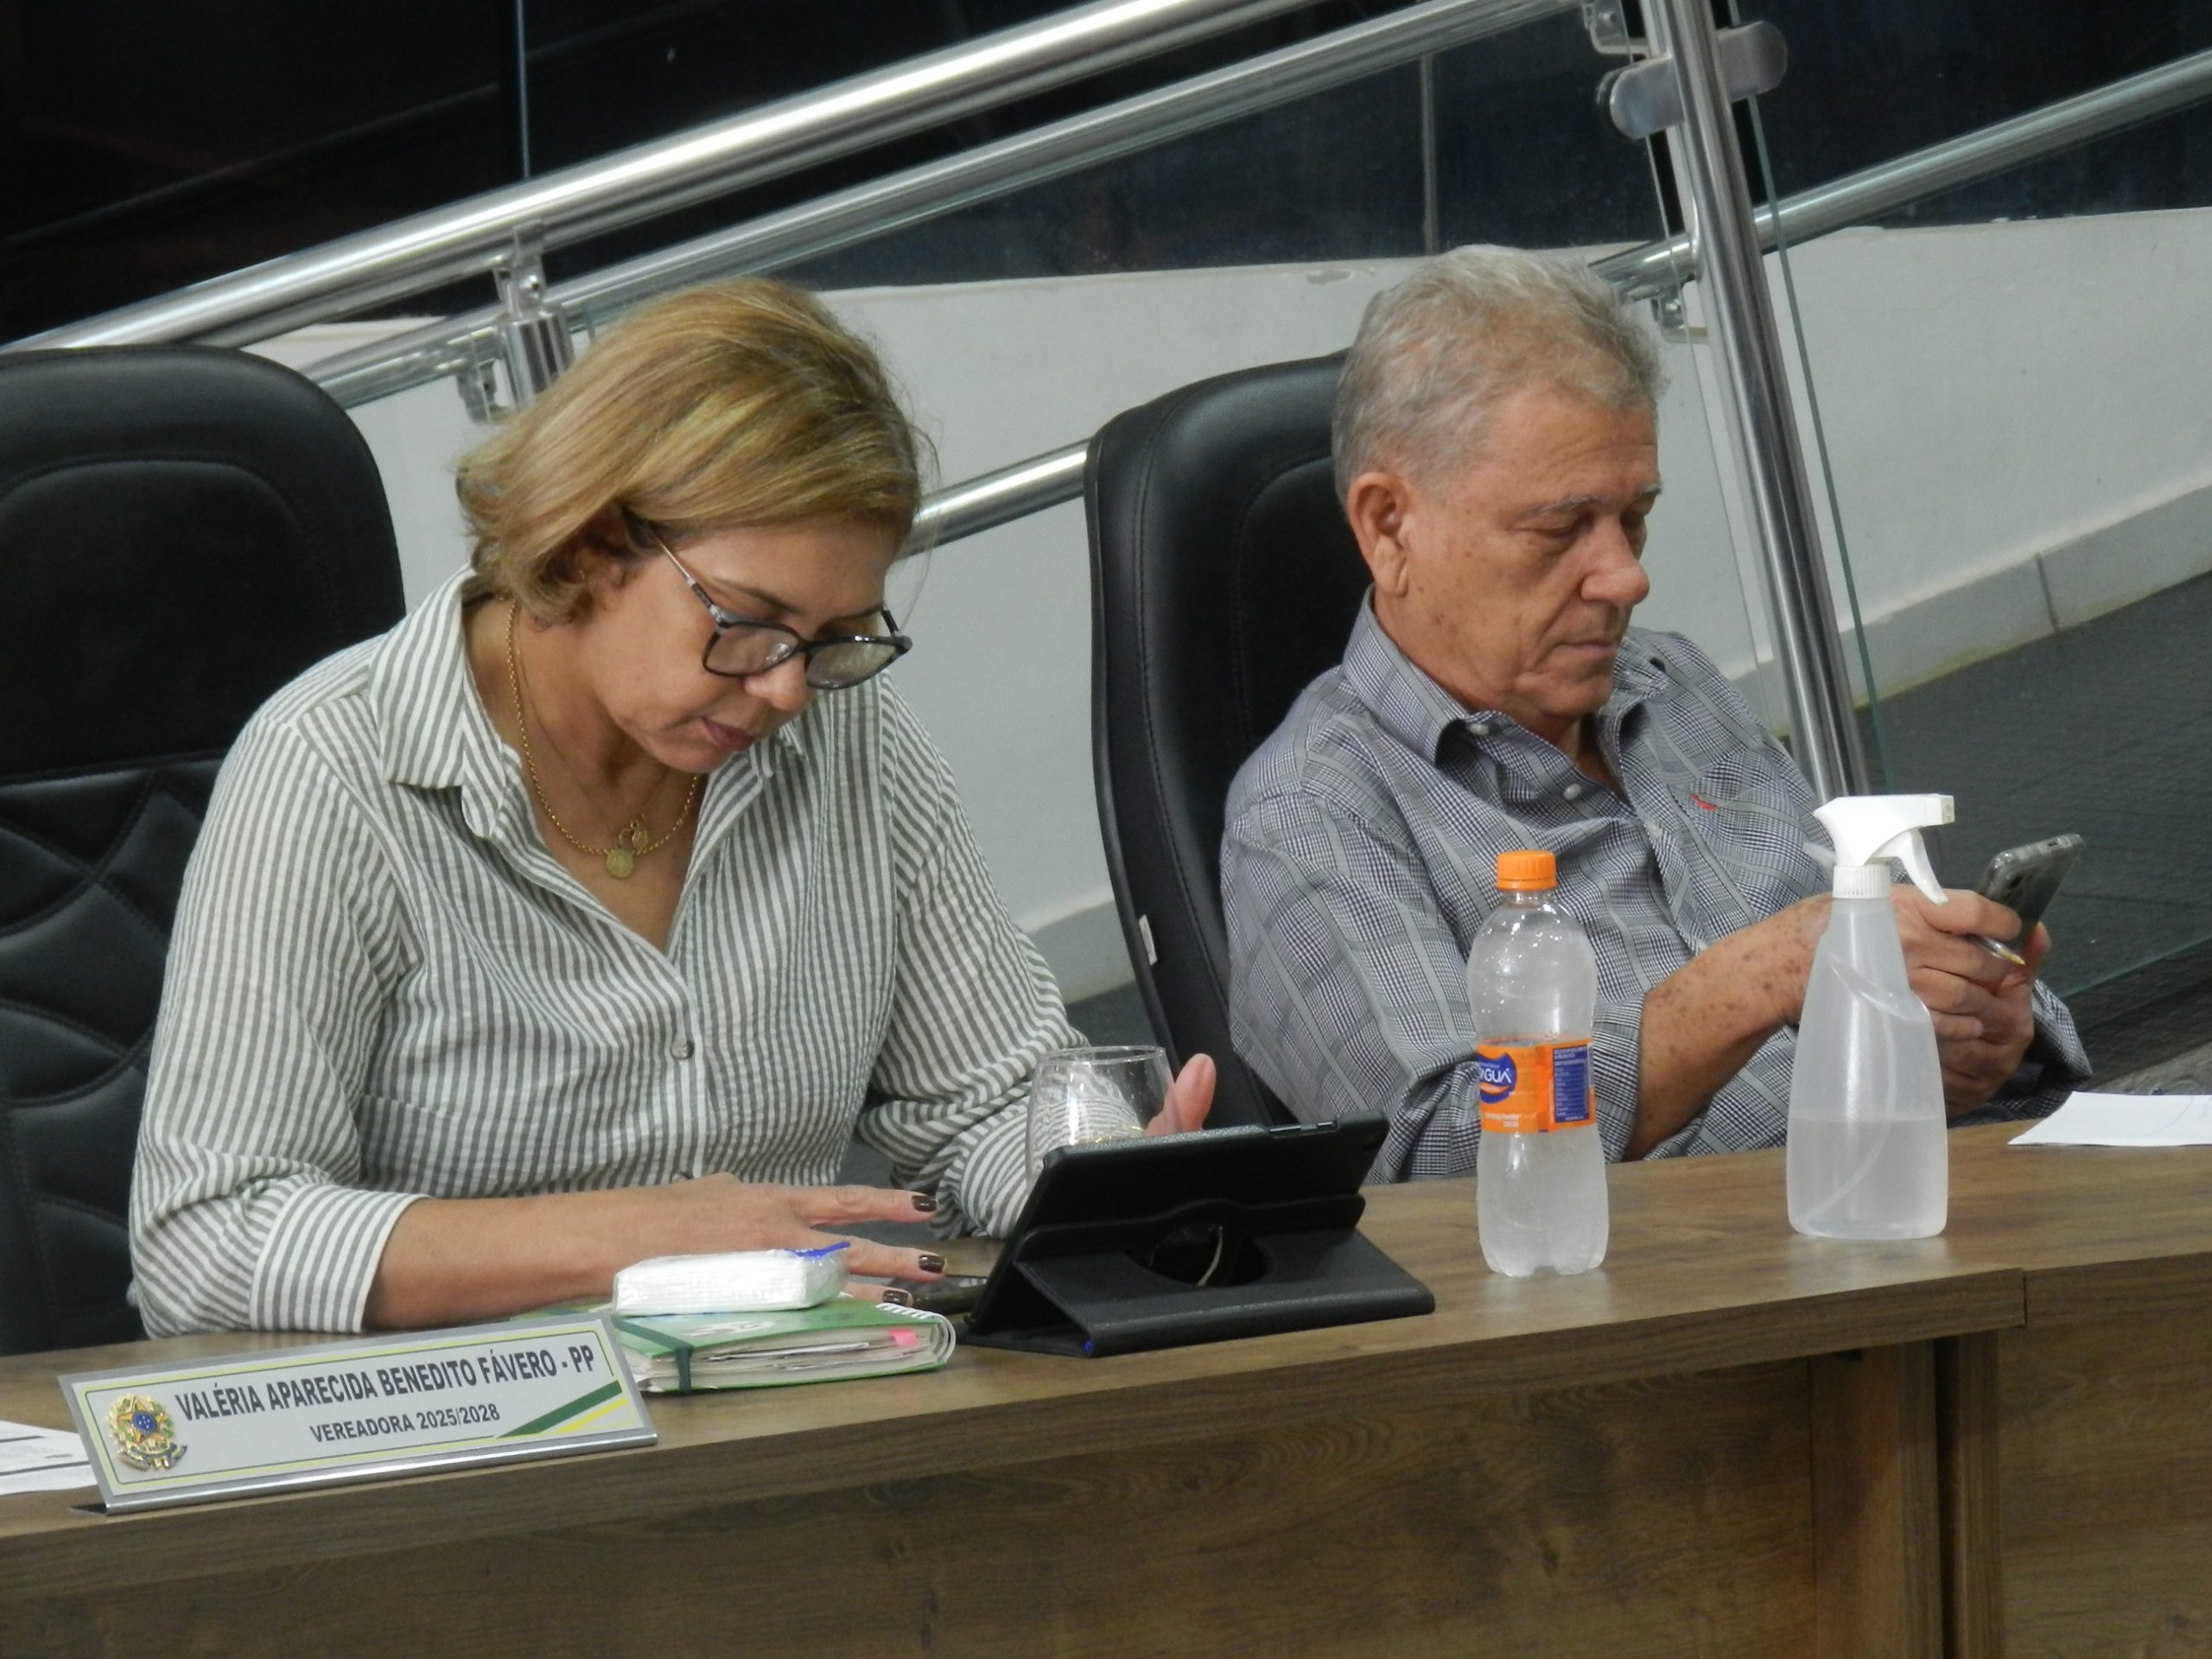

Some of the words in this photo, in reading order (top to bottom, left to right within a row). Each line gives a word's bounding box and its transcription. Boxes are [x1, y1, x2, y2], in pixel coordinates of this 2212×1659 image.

[175, 1382, 265, 1421] VALÉRIA
[266, 1371, 378, 1410] APARECIDA
[378, 1359, 478, 1396] BENEDITO
[477, 1349, 557, 1384] FÁVERO
[569, 1345, 594, 1373] PP
[309, 1415, 415, 1442] VEREADORA
[416, 1403, 501, 1430] 2025/2028
